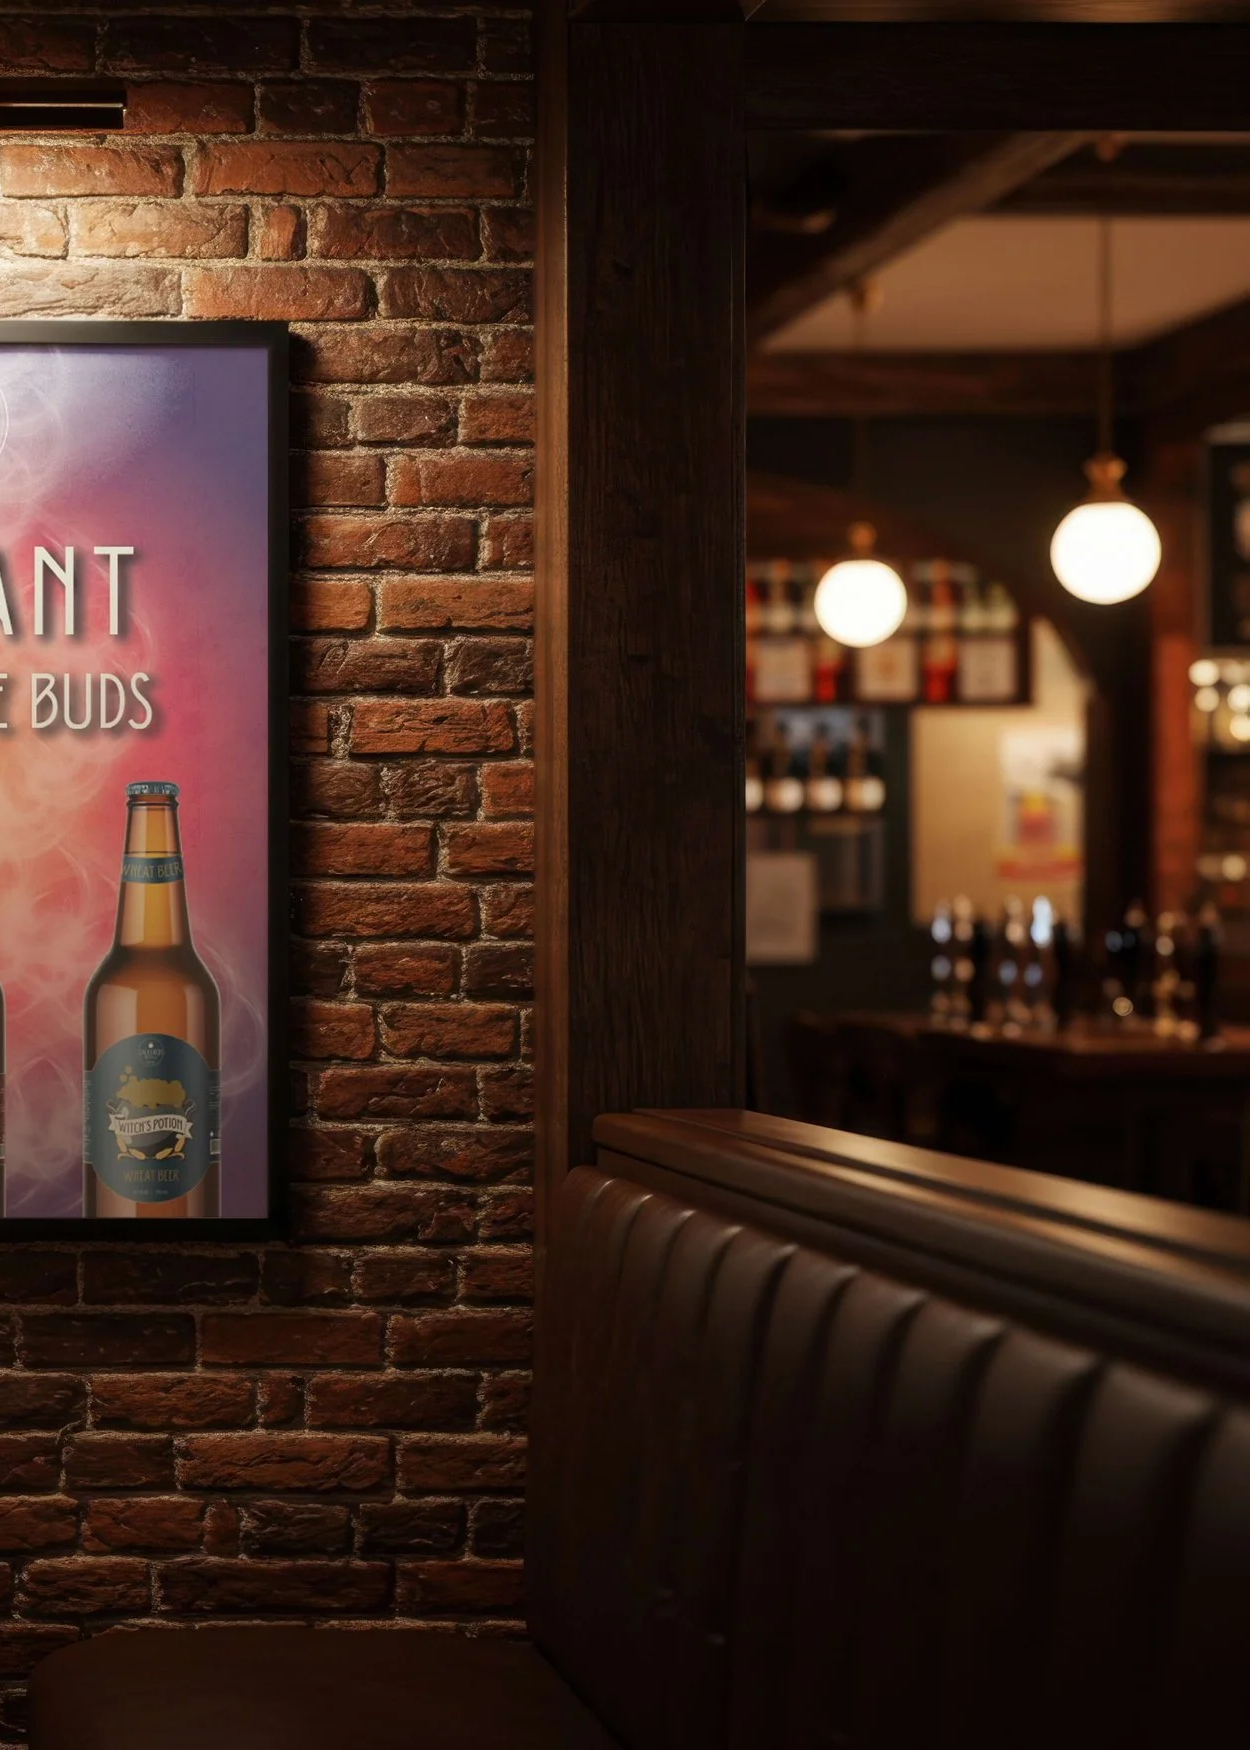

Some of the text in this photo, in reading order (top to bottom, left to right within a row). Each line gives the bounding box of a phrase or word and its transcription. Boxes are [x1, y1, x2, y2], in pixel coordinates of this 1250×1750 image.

[31, 672, 153, 730] BUDS
[157, 862, 182, 878] BEER
[118, 1117, 183, 1134] WITCH'S POTION
[123, 1169, 180, 1182] WHEAT BEER
